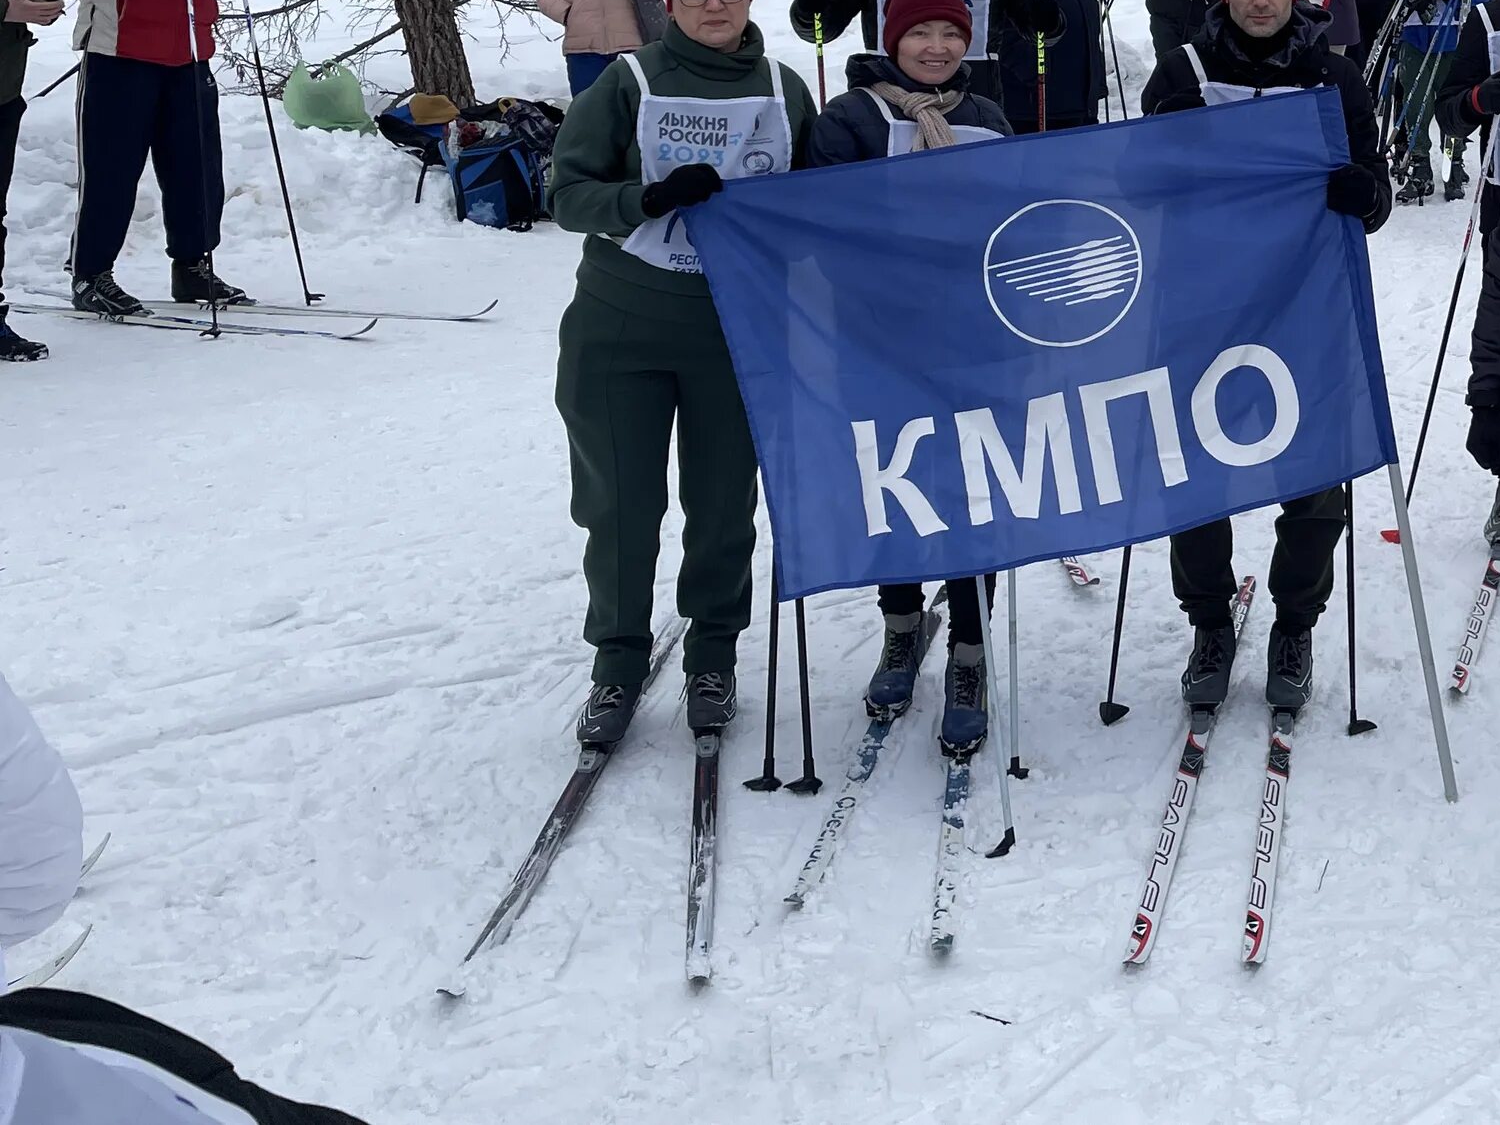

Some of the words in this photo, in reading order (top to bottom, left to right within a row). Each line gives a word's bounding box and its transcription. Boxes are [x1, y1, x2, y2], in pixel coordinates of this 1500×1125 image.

[657, 112, 729, 132] ЛЫЖНЯ
[657, 143, 725, 167] 2023
[658, 127, 728, 147] РОССИИ
[850, 344, 1299, 537] КМПО
[1458, 588, 1490, 665] SABLE
[1139, 777, 1188, 913] SABLE
[1248, 776, 1281, 910] SABLE
